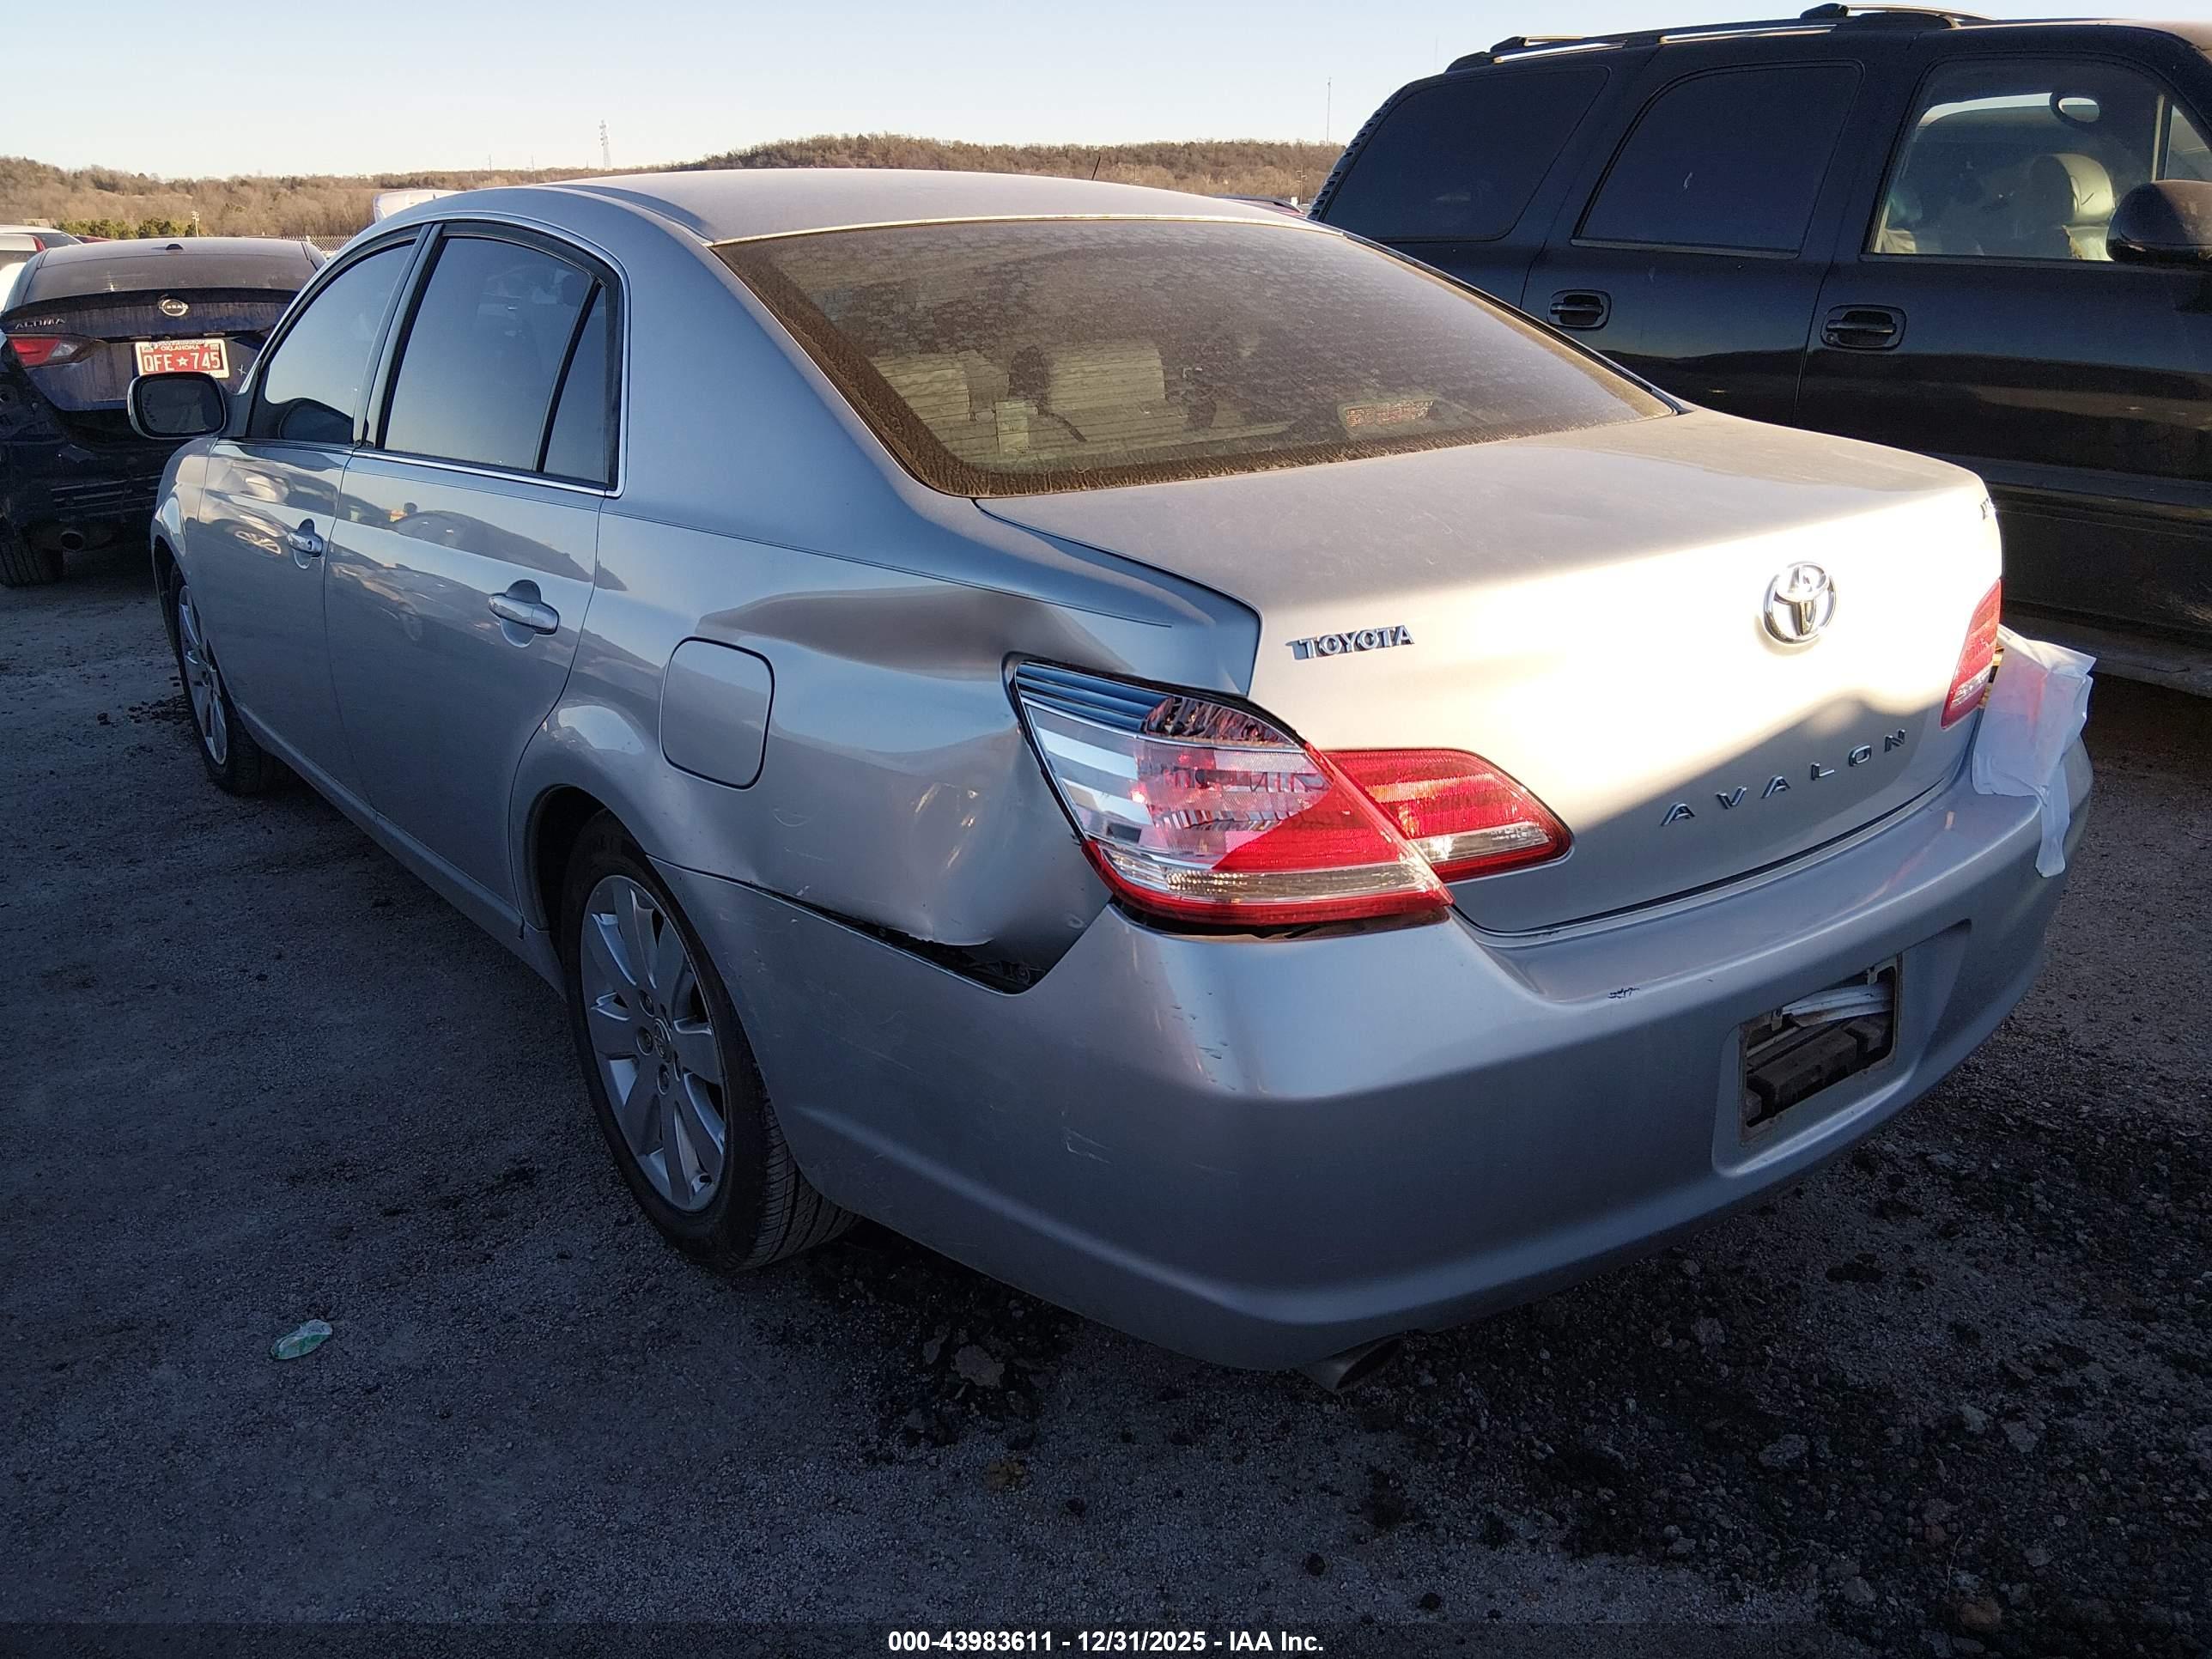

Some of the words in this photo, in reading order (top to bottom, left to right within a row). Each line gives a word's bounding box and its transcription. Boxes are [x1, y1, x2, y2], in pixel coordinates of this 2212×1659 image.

[15, 318, 66, 330] ALTIMA
[143, 354, 175, 372] QFE
[189, 351, 221, 370] 745
[1285, 625, 1415, 660] TOYOTA
[1661, 729, 1906, 827] AVALON
